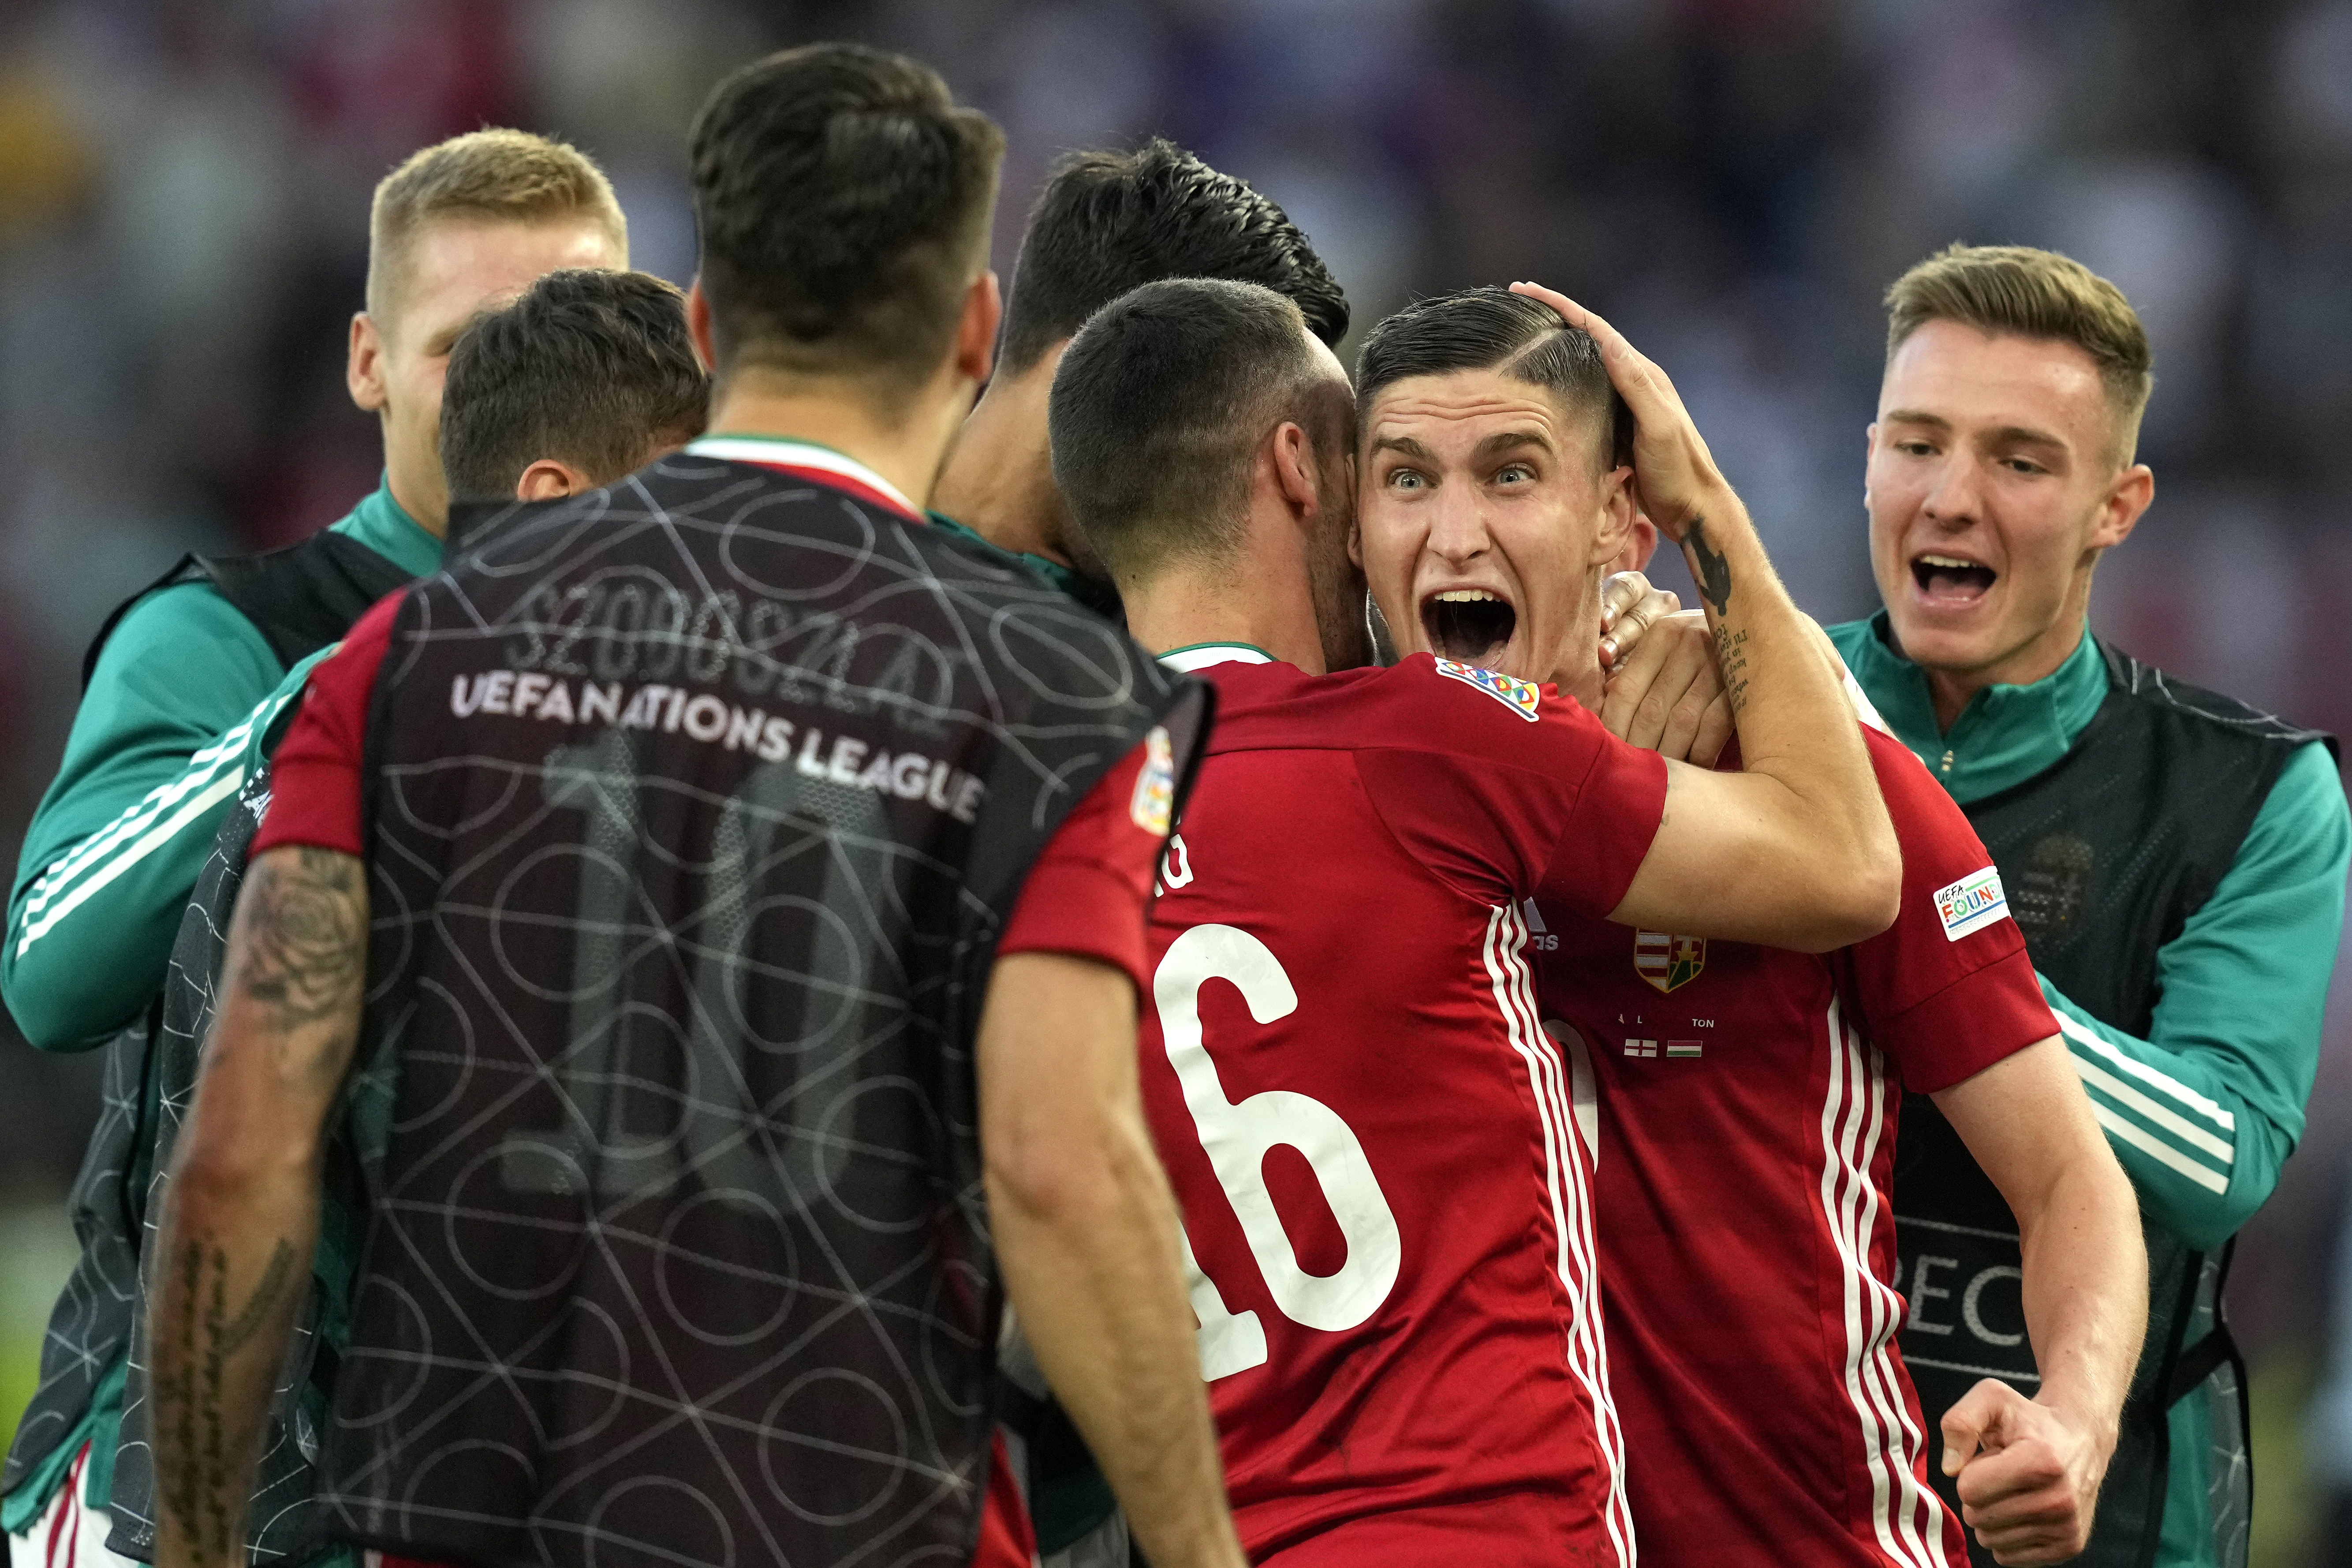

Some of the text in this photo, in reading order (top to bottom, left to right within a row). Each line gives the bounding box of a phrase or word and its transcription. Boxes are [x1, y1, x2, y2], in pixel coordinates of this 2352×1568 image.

[452, 671, 986, 825] UEFA NATIONS LEAGUE
[1938, 884, 1964, 904] UEFA
[1892, 1254, 2023, 1347] EC
